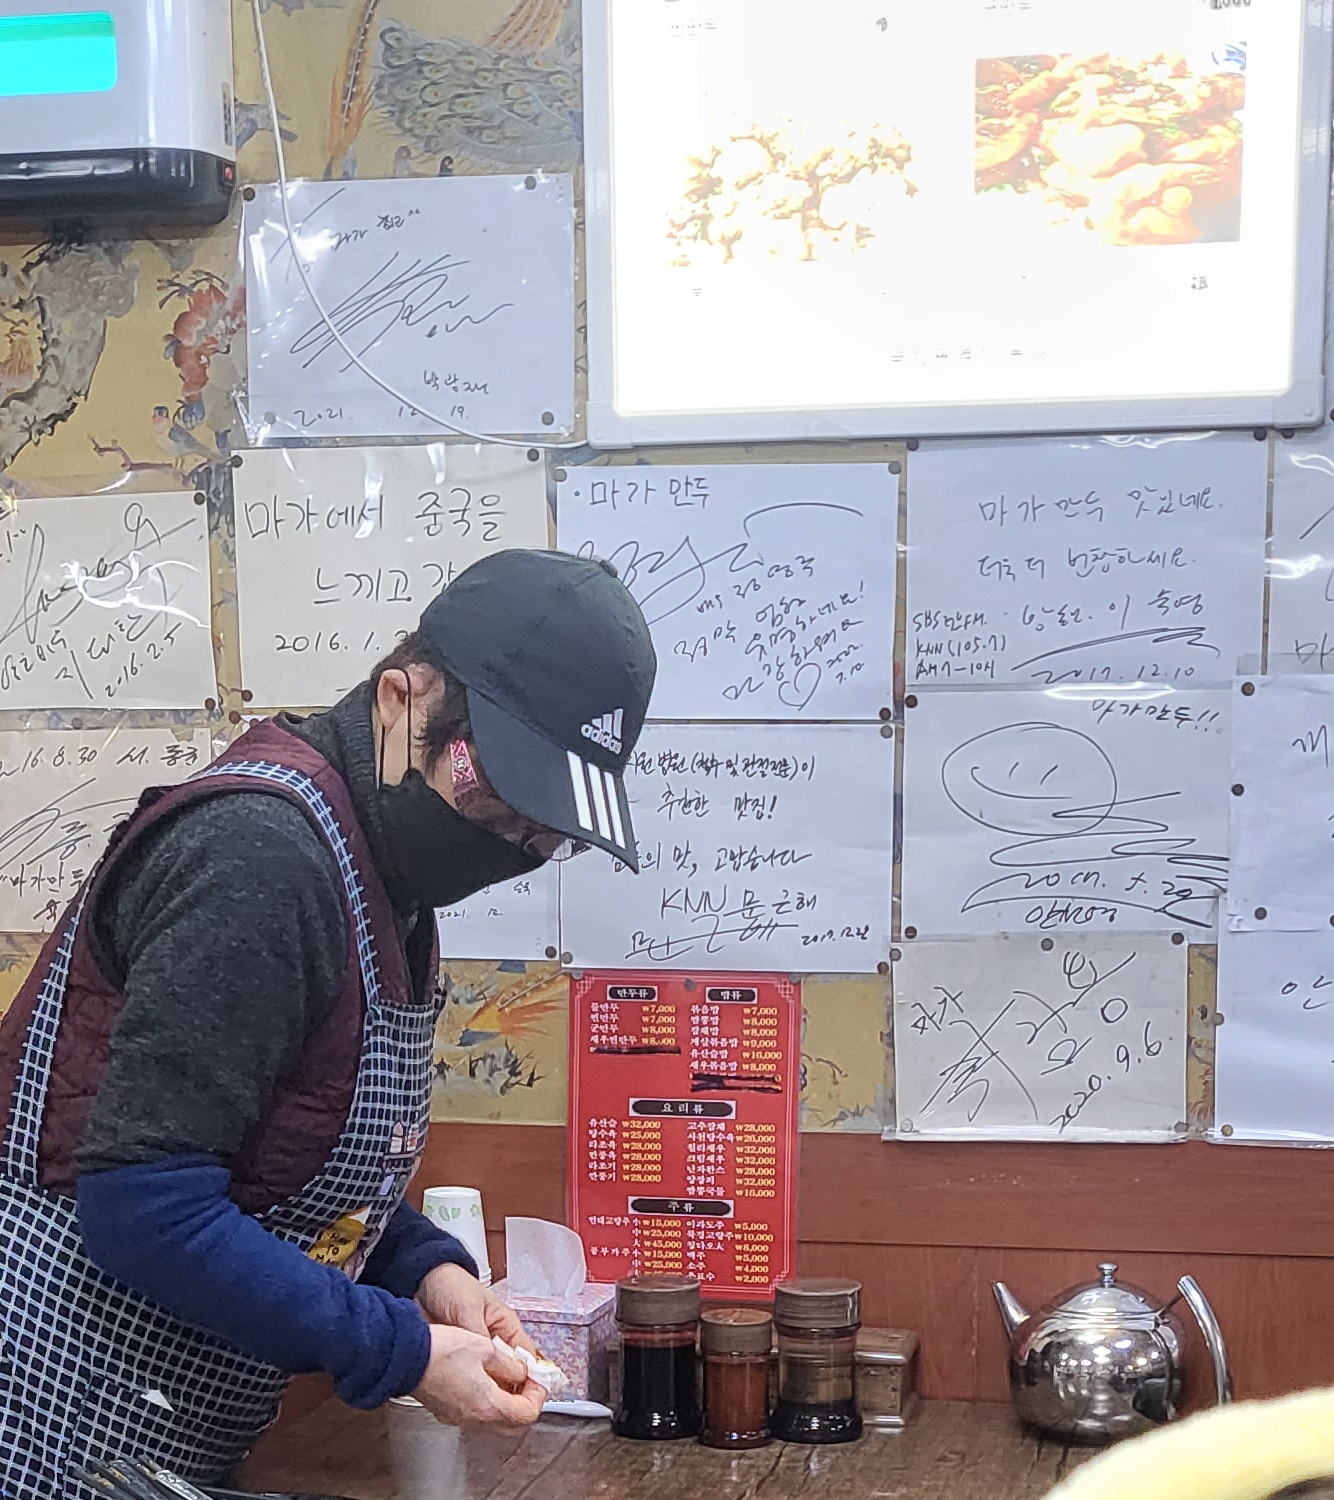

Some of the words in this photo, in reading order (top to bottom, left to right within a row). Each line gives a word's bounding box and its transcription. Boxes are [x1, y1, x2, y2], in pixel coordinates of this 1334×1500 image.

[244, 494, 386, 541] 마가에서
[414, 488, 508, 543] 중국을
[978, 494, 1045, 527] 마가
[312, 566, 414, 605] 느끼고
[275, 631, 349, 654] 2016.
[581, 724, 622, 754] adidas
[734, 792, 778, 821] 맛집!
[661, 884, 727, 920] KNN
